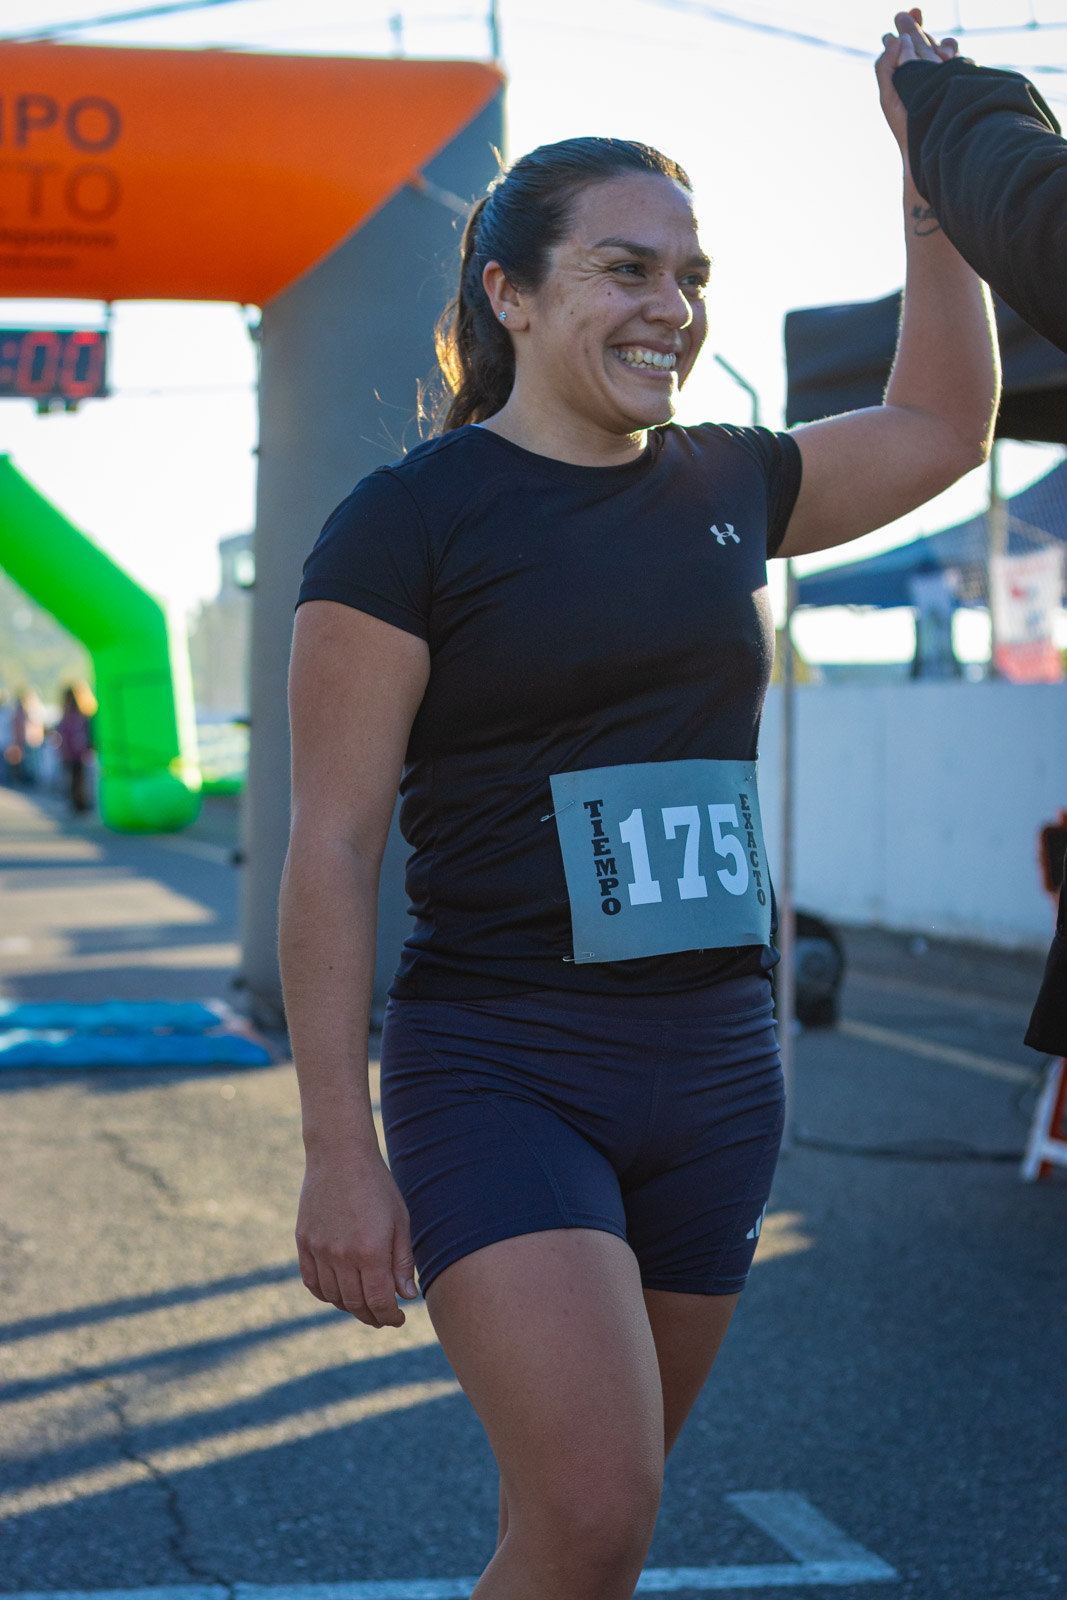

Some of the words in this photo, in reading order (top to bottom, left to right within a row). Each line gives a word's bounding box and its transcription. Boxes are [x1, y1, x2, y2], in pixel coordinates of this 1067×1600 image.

[0, 161, 123, 223] TO
[583, 800, 622, 916] TIEMPO
[618, 803, 750, 906] 175
[738, 793, 767, 907] EXACTO
